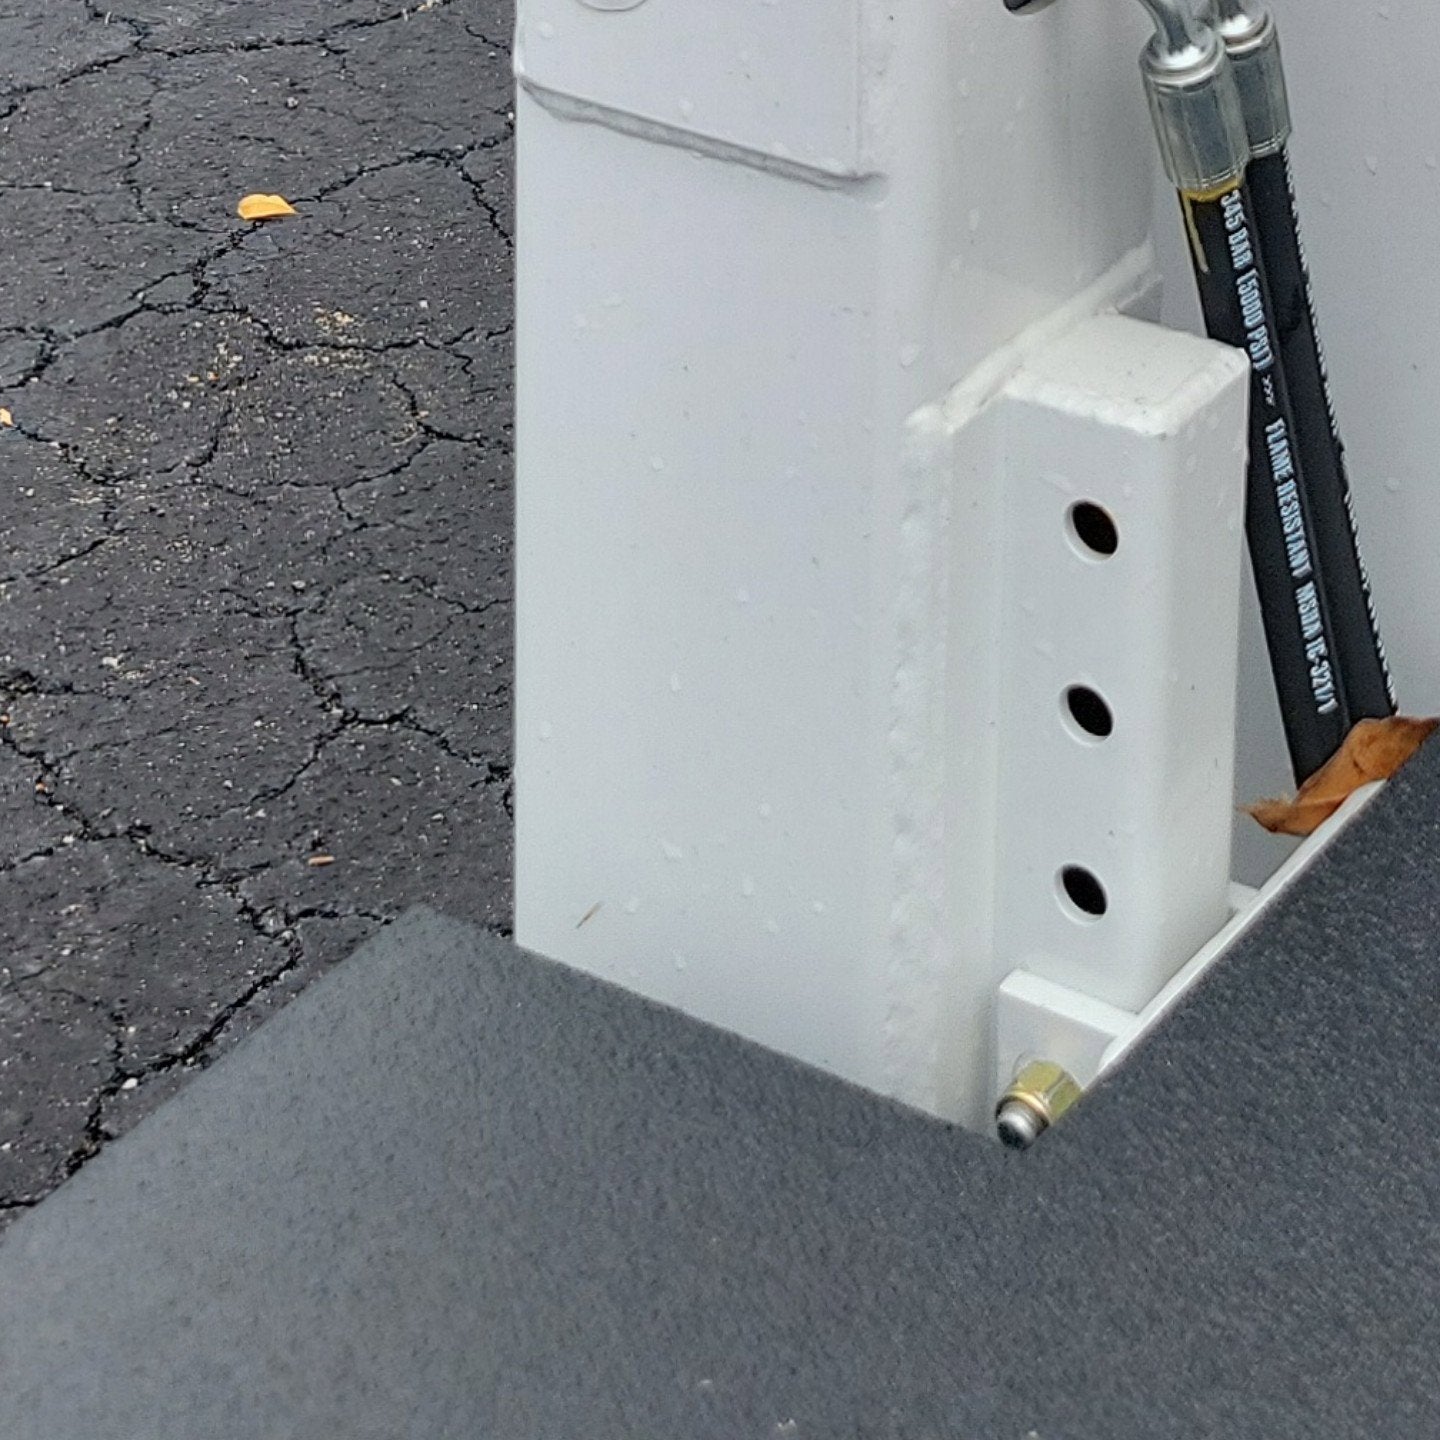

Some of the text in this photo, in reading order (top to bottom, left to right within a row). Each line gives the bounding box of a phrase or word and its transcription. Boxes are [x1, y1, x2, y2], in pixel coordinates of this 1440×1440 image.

[1220, 189, 1247, 229] 345
[1229, 227, 1253, 269] BAR
[1265, 418, 1293, 480] FLAME
[1276, 479, 1311, 577] RESISTANT
[1296, 581, 1323, 638] MSHA
